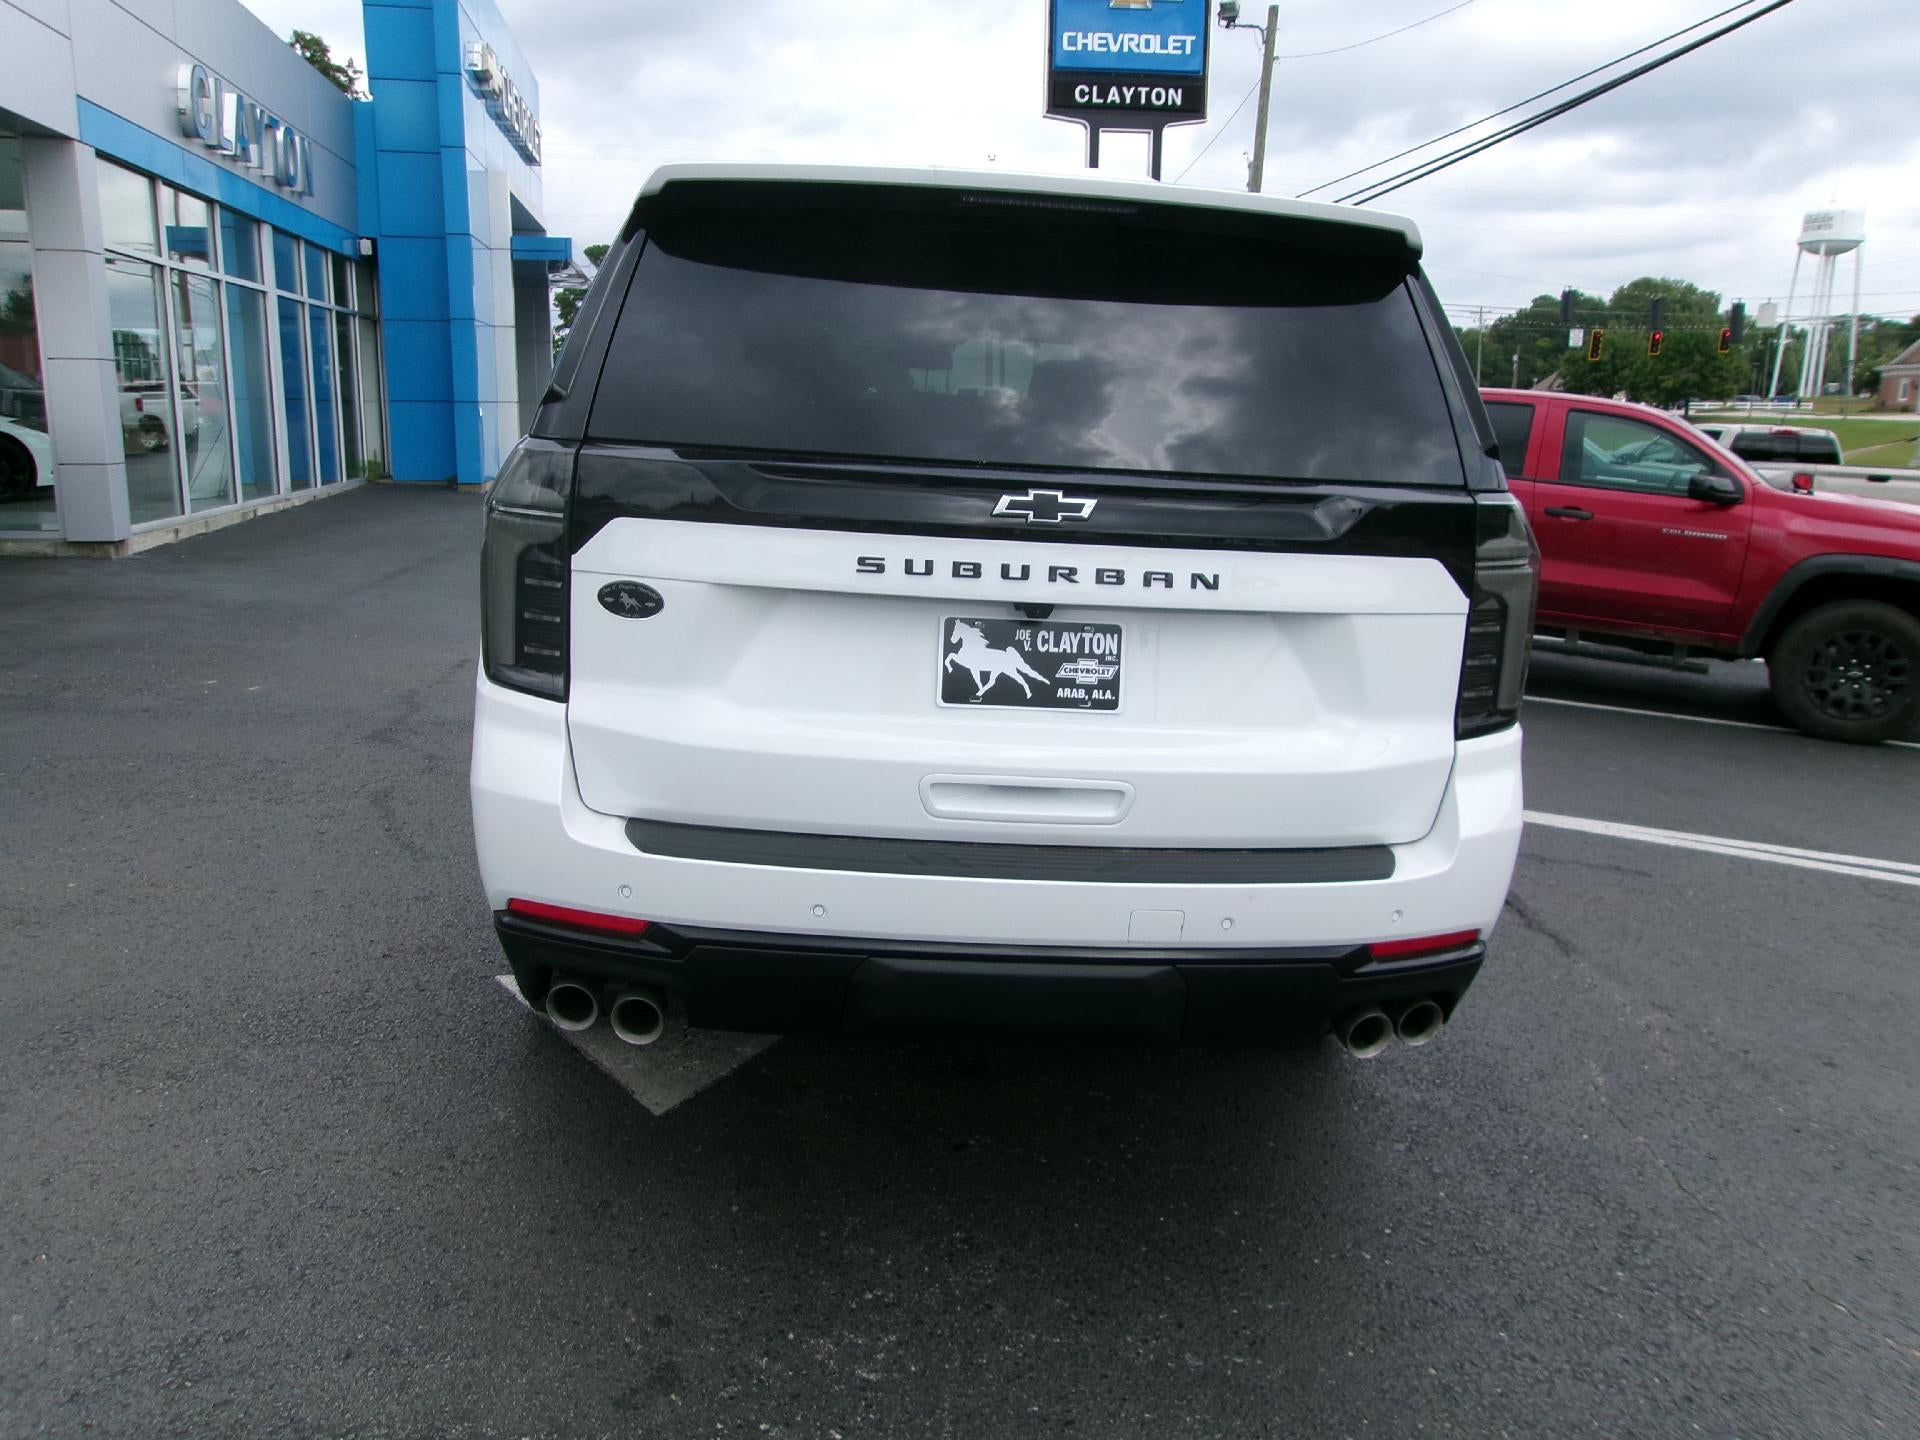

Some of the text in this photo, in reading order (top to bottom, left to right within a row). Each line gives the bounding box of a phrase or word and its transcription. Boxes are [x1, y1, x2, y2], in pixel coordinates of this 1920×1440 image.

[1062, 31, 1197, 55] CHEVROLET
[1074, 84, 1183, 106] CLAYTON
[178, 64, 315, 197] CLAYTON
[856, 556, 1220, 590] SUBURBAN
[1014, 629, 1032, 641] JOE
[1023, 640, 1032, 652] V.
[1036, 630, 1118, 655] CLAYTON
[1063, 667, 1111, 675] CHEVROLET
[1056, 687, 1116, 701] ARAB, ALA.
